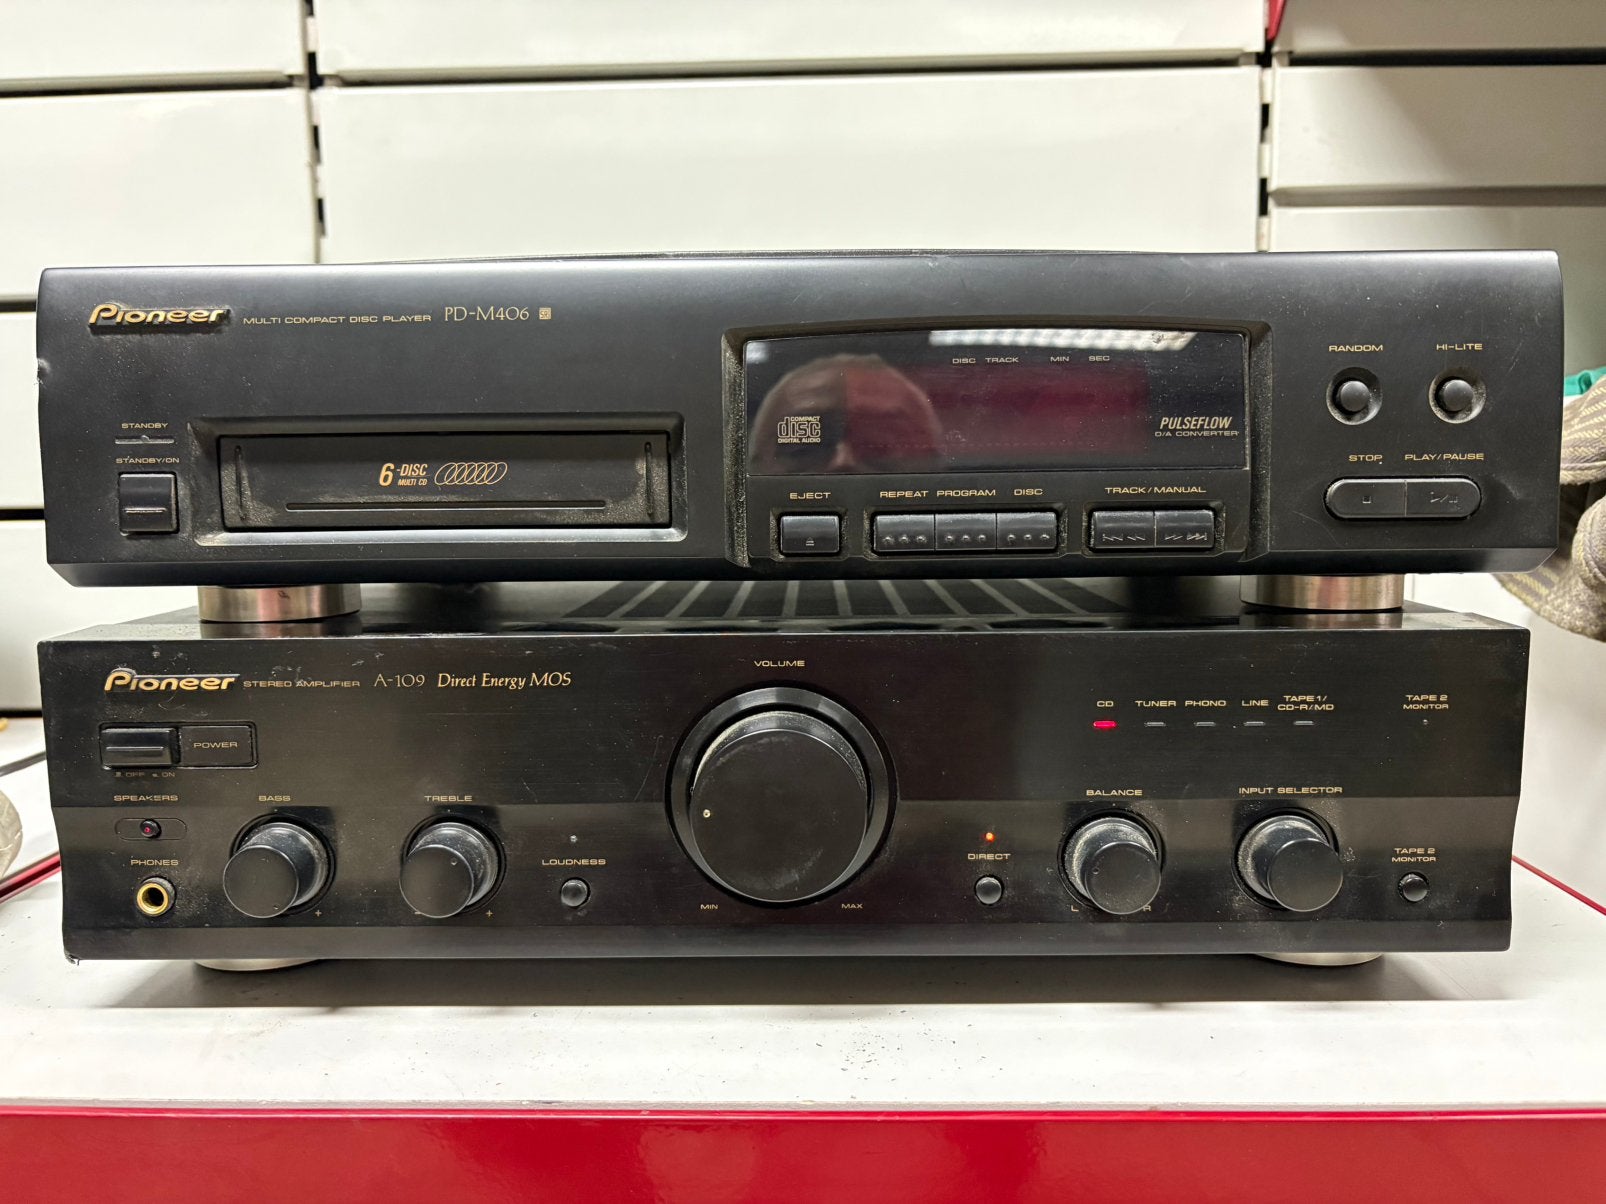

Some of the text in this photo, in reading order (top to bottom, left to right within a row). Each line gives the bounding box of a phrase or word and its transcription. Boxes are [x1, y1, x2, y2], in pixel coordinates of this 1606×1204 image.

[88, 304, 224, 325] Pioneer
[243, 317, 281, 325] MULTI
[284, 316, 345, 324] COMPACT
[350, 315, 378, 323] DISC
[382, 315, 432, 323] PLAYER
[444, 306, 530, 322] PD-M406
[1436, 343, 1483, 351] HI-LITE
[952, 357, 976, 365] DISC
[1160, 416, 1233, 430] PULSEFLOW
[1348, 454, 1383, 462] STOP
[1405, 453, 1484, 461] PLAY/PAUSE
[398, 478, 428, 486] MULTI CD
[789, 491, 831, 499] EJECT
[879, 490, 929, 498] REPEAT
[936, 489, 996, 497] PROGRAM
[1014, 488, 1043, 496] DISC
[104, 671, 236, 692] Pioneer
[243, 672, 572, 689] STEREO AMPLIFIER A-109 Direct Energy MOS
[1096, 700, 1114, 708] CD
[1241, 699, 1269, 707] LINE
[1238, 786, 1343, 795] INPUT SELECTOR
[113, 794, 179, 802] SPEAKERS
[967, 853, 1011, 861] DIRECT
[541, 858, 606, 866] LOUDNESS
